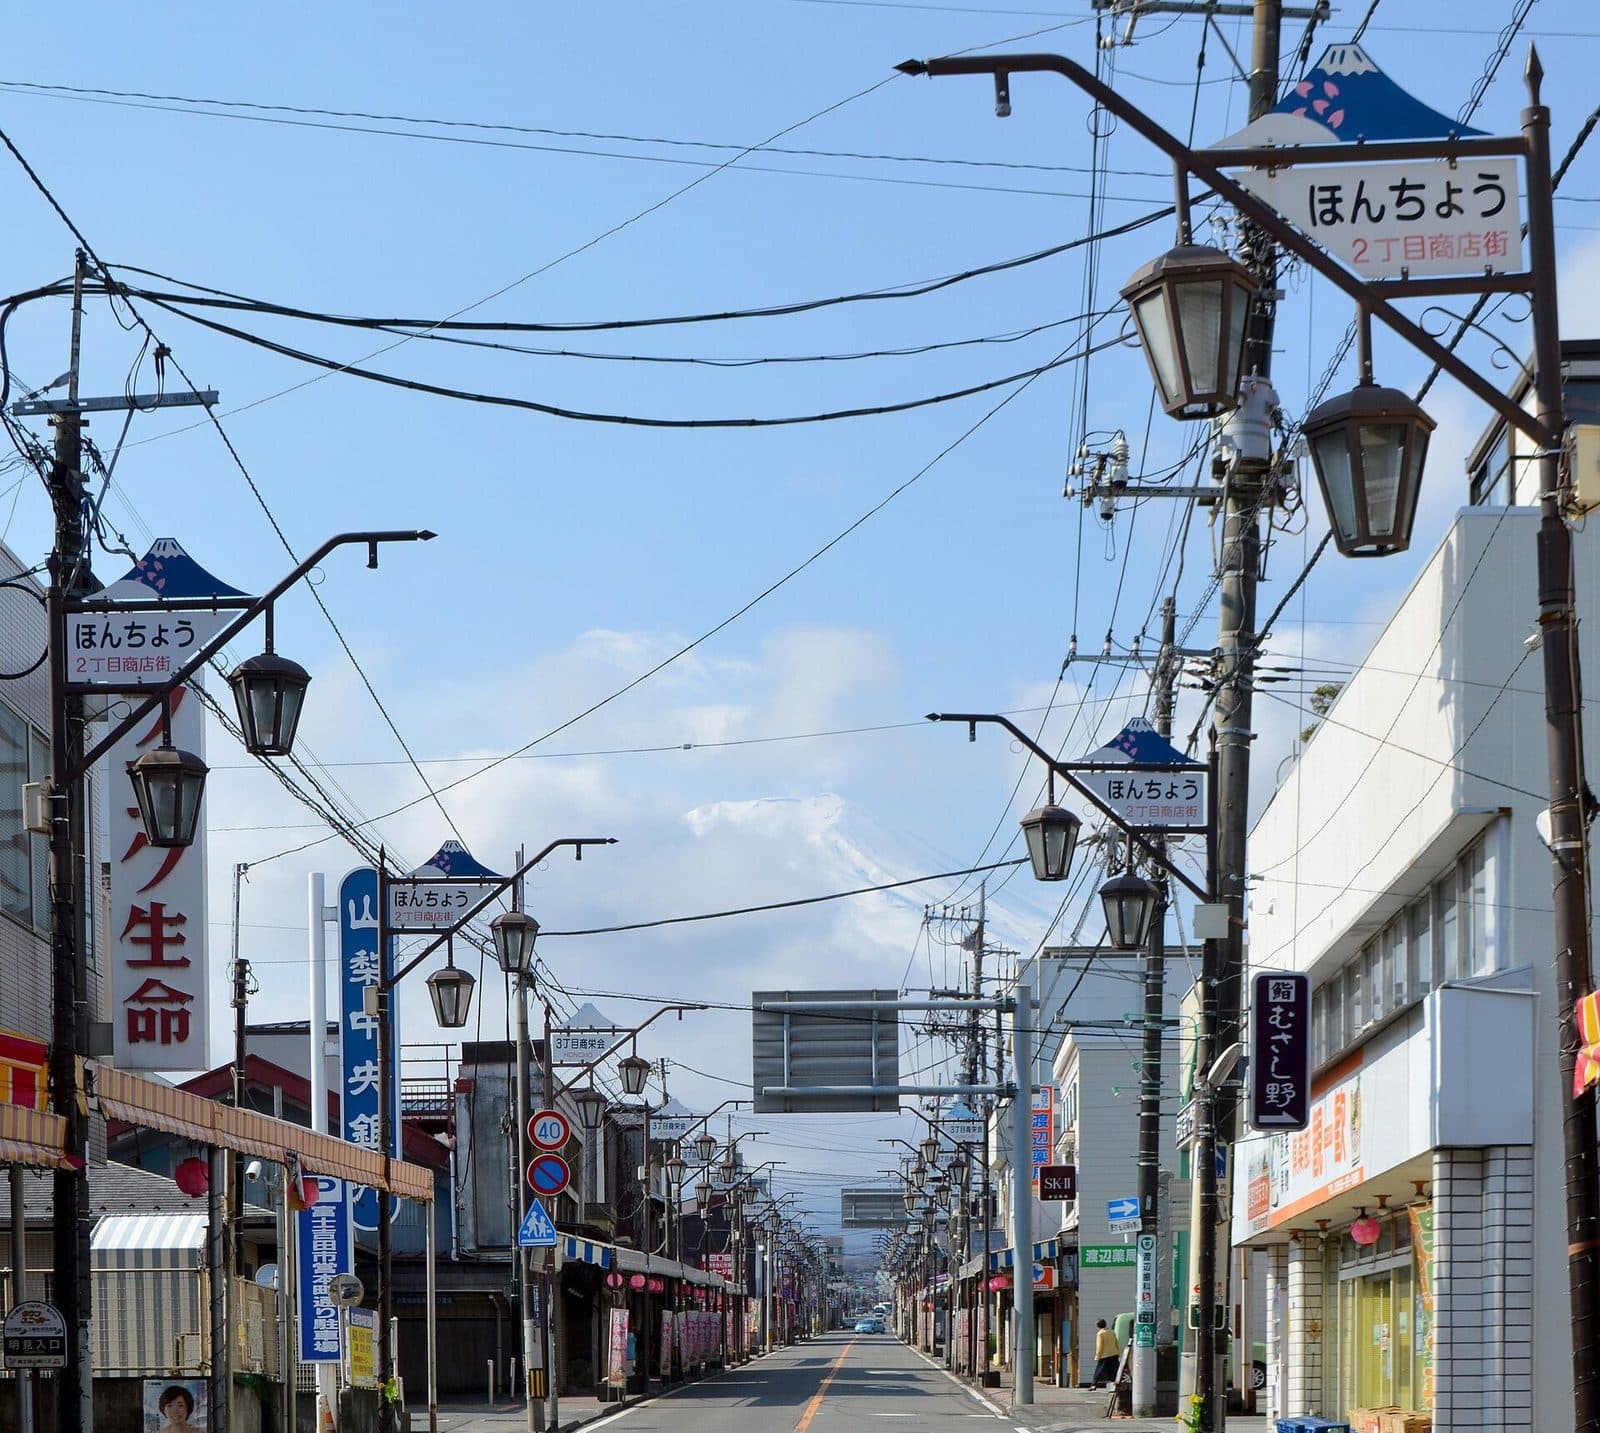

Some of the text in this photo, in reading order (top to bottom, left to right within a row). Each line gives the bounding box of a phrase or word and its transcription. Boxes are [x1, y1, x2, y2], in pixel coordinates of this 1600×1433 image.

[1309, 172, 1506, 227] ほんちょう
[1351, 230, 1509, 265] 2丁目商店街
[75, 620, 195, 650] ほんちょう
[76, 656, 171, 673] 2丁目商店街
[1108, 779, 1199, 800] ほんちょう
[1126, 805, 1198, 817] 2丁目商店街
[394, 890, 469, 908] ほんちょう
[394, 911, 454, 922] 2丁目商店街
[1271, 982, 1294, 1000] 鮨
[556, 1038, 606, 1050] 3丁目商栄会
[1266, 1005, 1296, 1107] むさし野
[538, 1122, 561, 1140] 40
[8, 1339, 60, 1350] 明見入口
